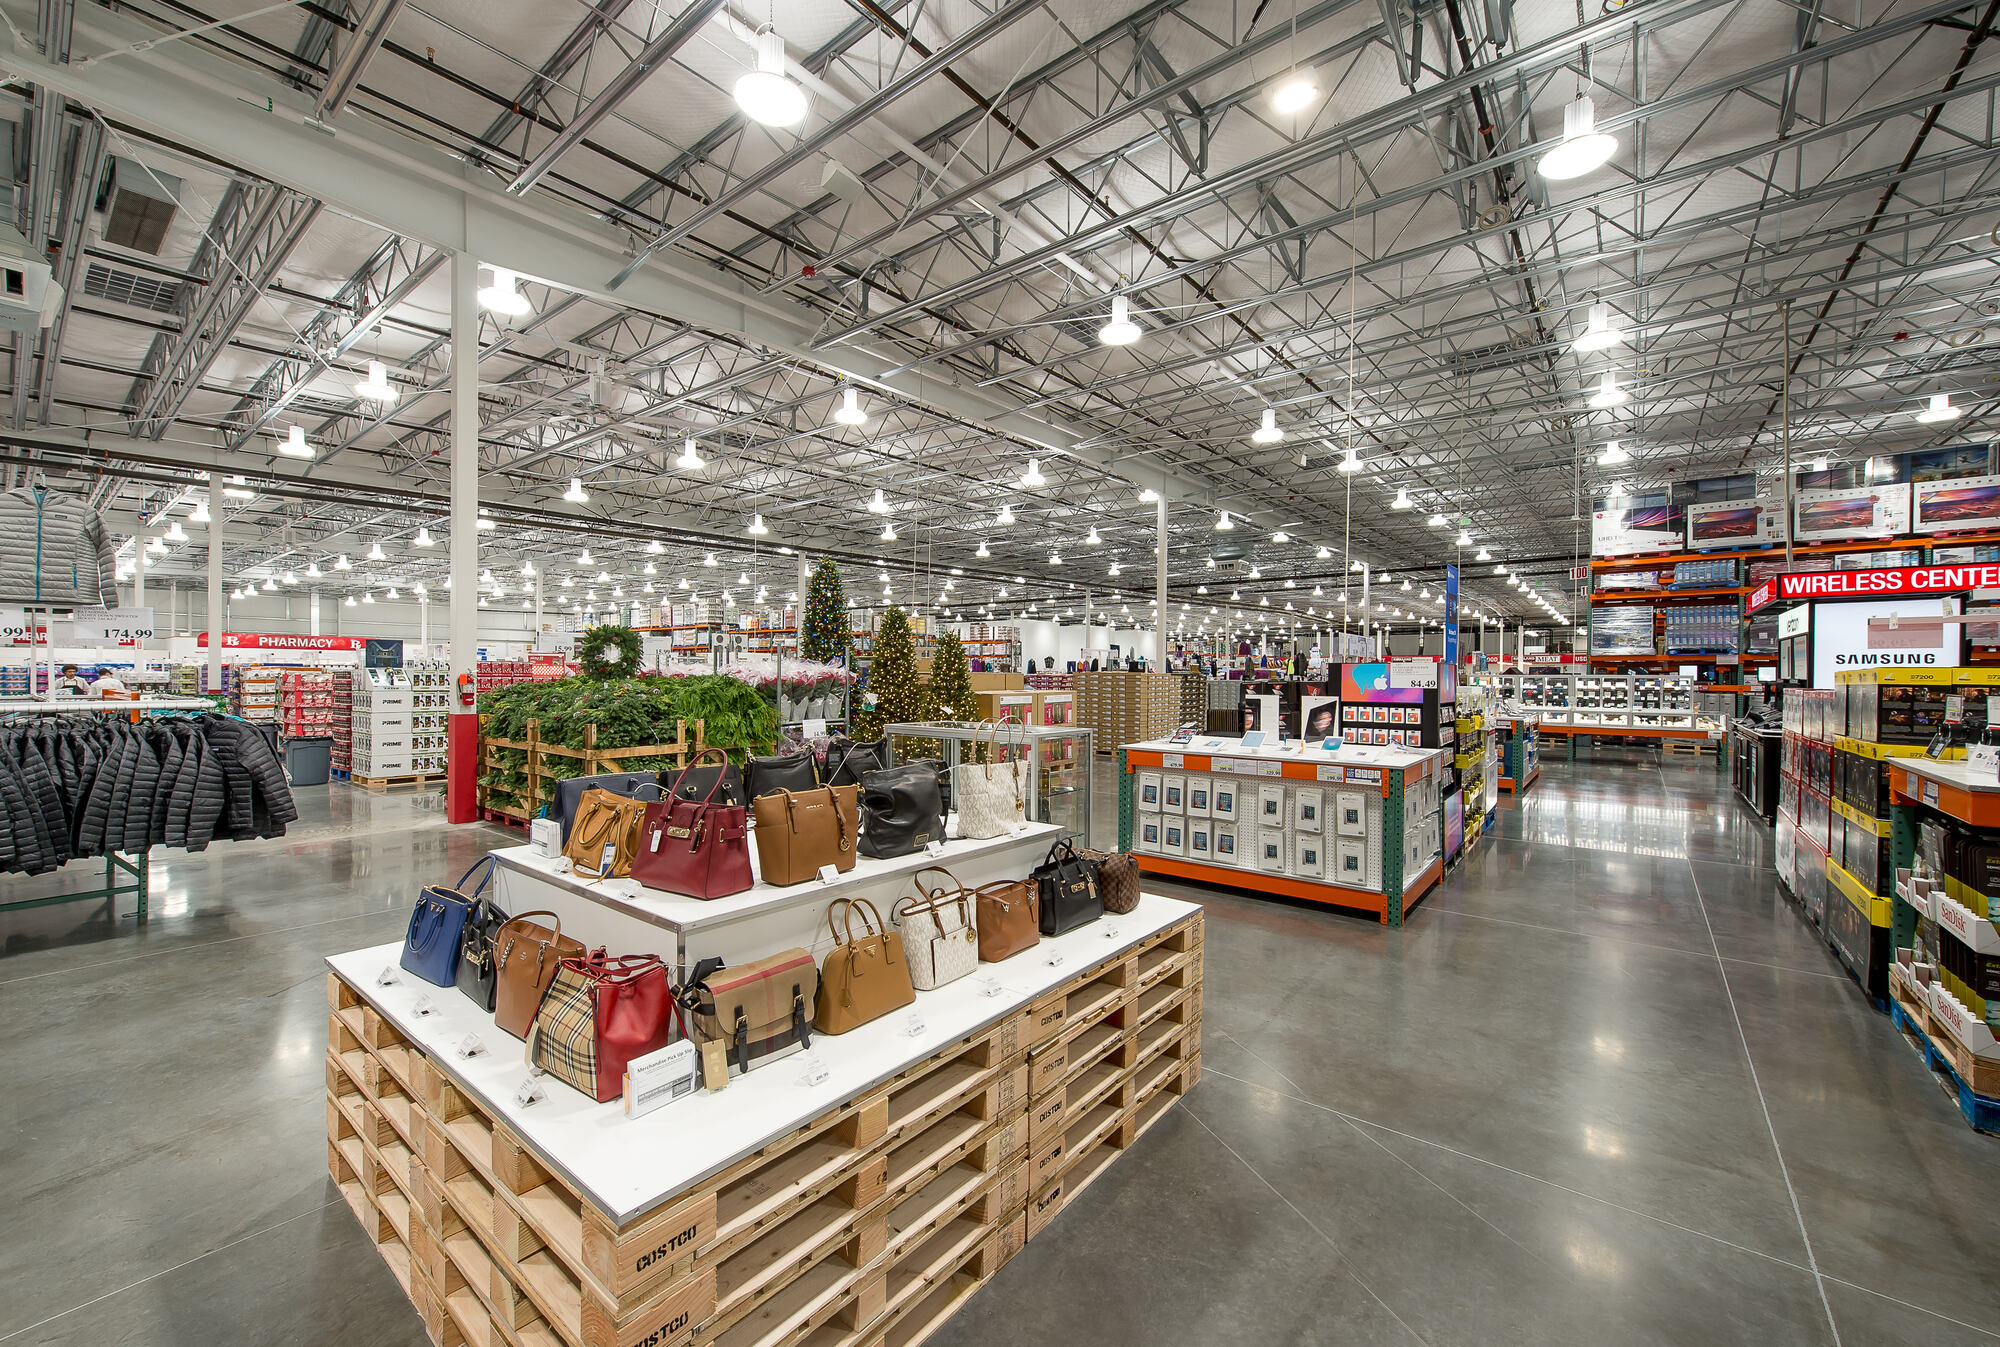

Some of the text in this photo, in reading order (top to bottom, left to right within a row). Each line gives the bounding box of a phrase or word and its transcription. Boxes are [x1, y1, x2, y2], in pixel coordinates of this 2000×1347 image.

[1570, 567, 1588, 579] 100
[1784, 566, 2000, 594] WIRELESS CENTE
[103, 628, 153, 639] 174.99
[258, 636, 334, 648] PHARMACY
[1835, 653, 1936, 665] SAMSUNG
[1410, 680, 1436, 688] 84.49
[1941, 902, 1966, 934] SanDisk
[1040, 1010, 1063, 1027] COSTCO
[1937, 994, 1963, 1032] SanDisk
[637, 1058, 667, 1073] Merchandise
[667, 1054, 676, 1063] Pick
[677, 1051, 684, 1059] Up
[1042, 1055, 1065, 1075] COSTCO
[1039, 1100, 1063, 1123] COSTCO
[1039, 1146, 1062, 1169] COSTCO
[636, 1225, 697, 1272] COSTCO
[631, 1310, 689, 1347] OSTCO
